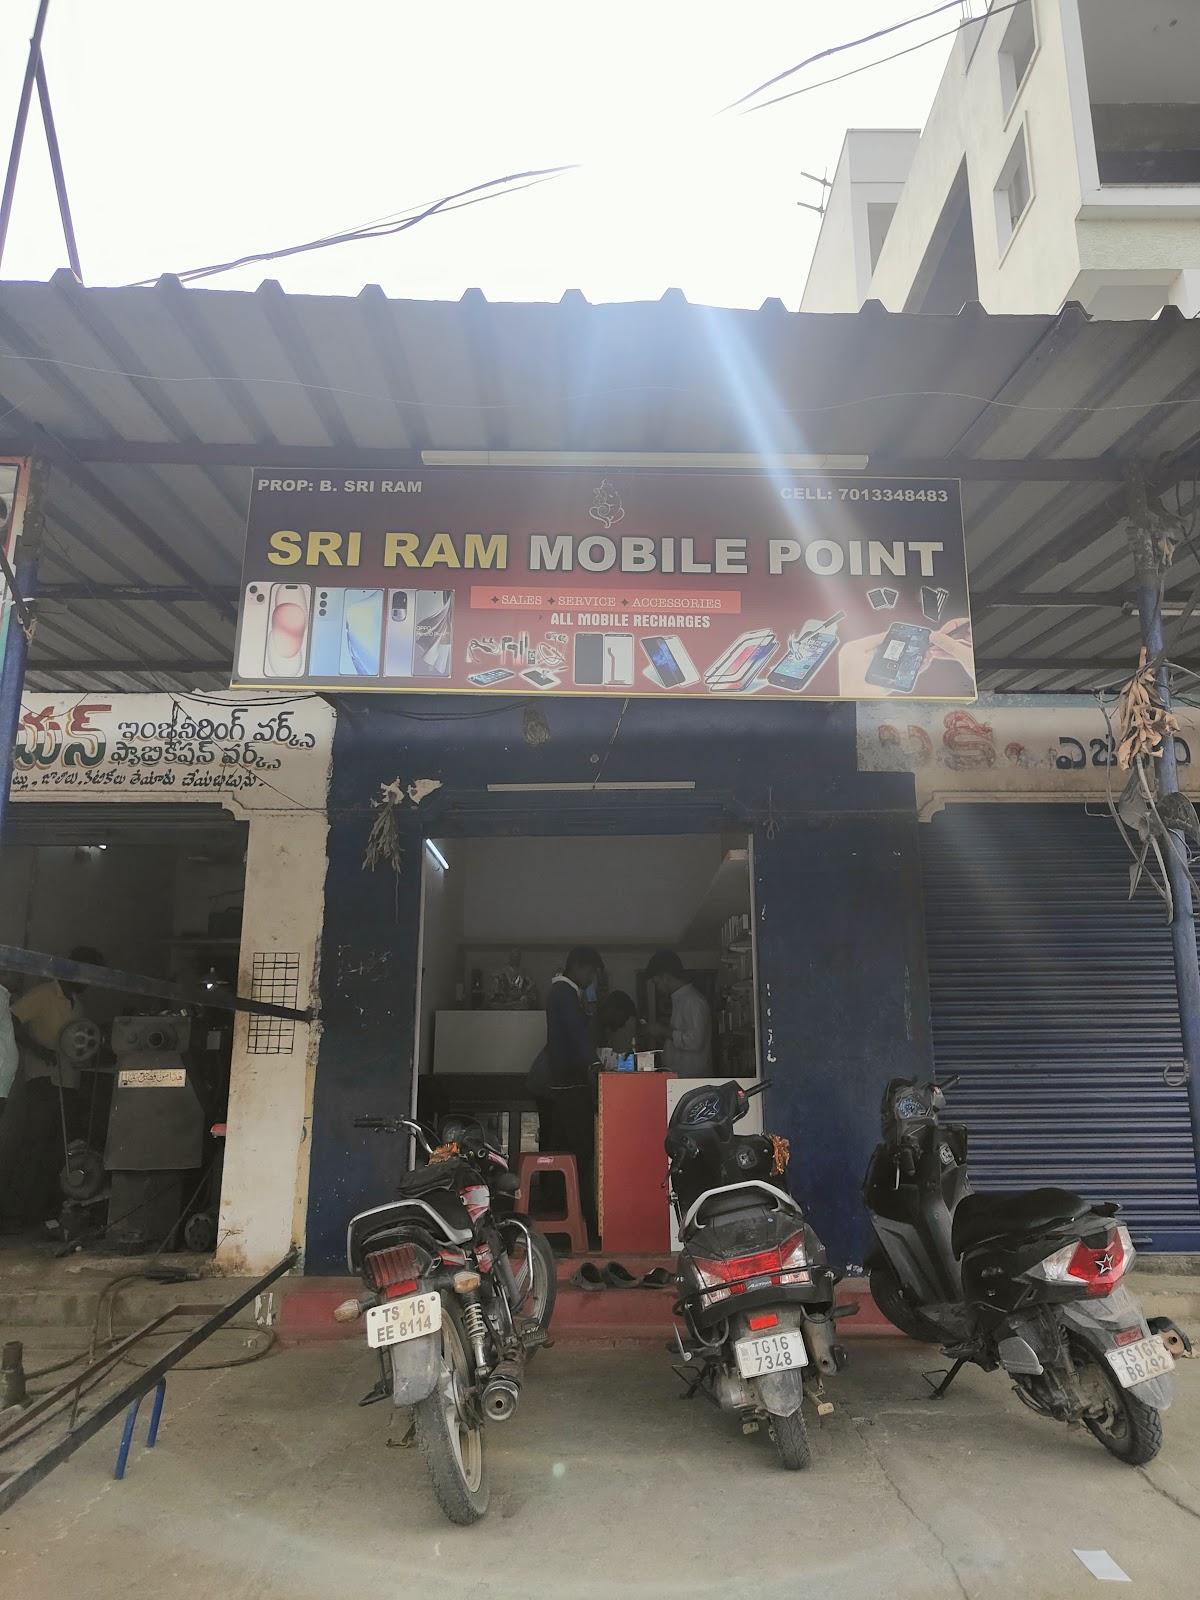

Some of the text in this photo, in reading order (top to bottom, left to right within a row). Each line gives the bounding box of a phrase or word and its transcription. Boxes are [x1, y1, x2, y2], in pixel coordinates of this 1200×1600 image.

[257, 479, 423, 494] PROP: B. SRI RAM
[780, 487, 949, 503] CELL: 7013348483
[266, 529, 944, 577] SRI RAM MOBILE POINT
[500, 594, 722, 610] SALES SERVICE ACCESSORIES
[550, 612, 711, 629] ALL MOBILE RECHARGES
[382, 1299, 426, 1323] TS 16
[376, 1314, 432, 1343] EE 8114
[751, 1336, 790, 1357] TG16
[754, 1350, 793, 1373] 7348
